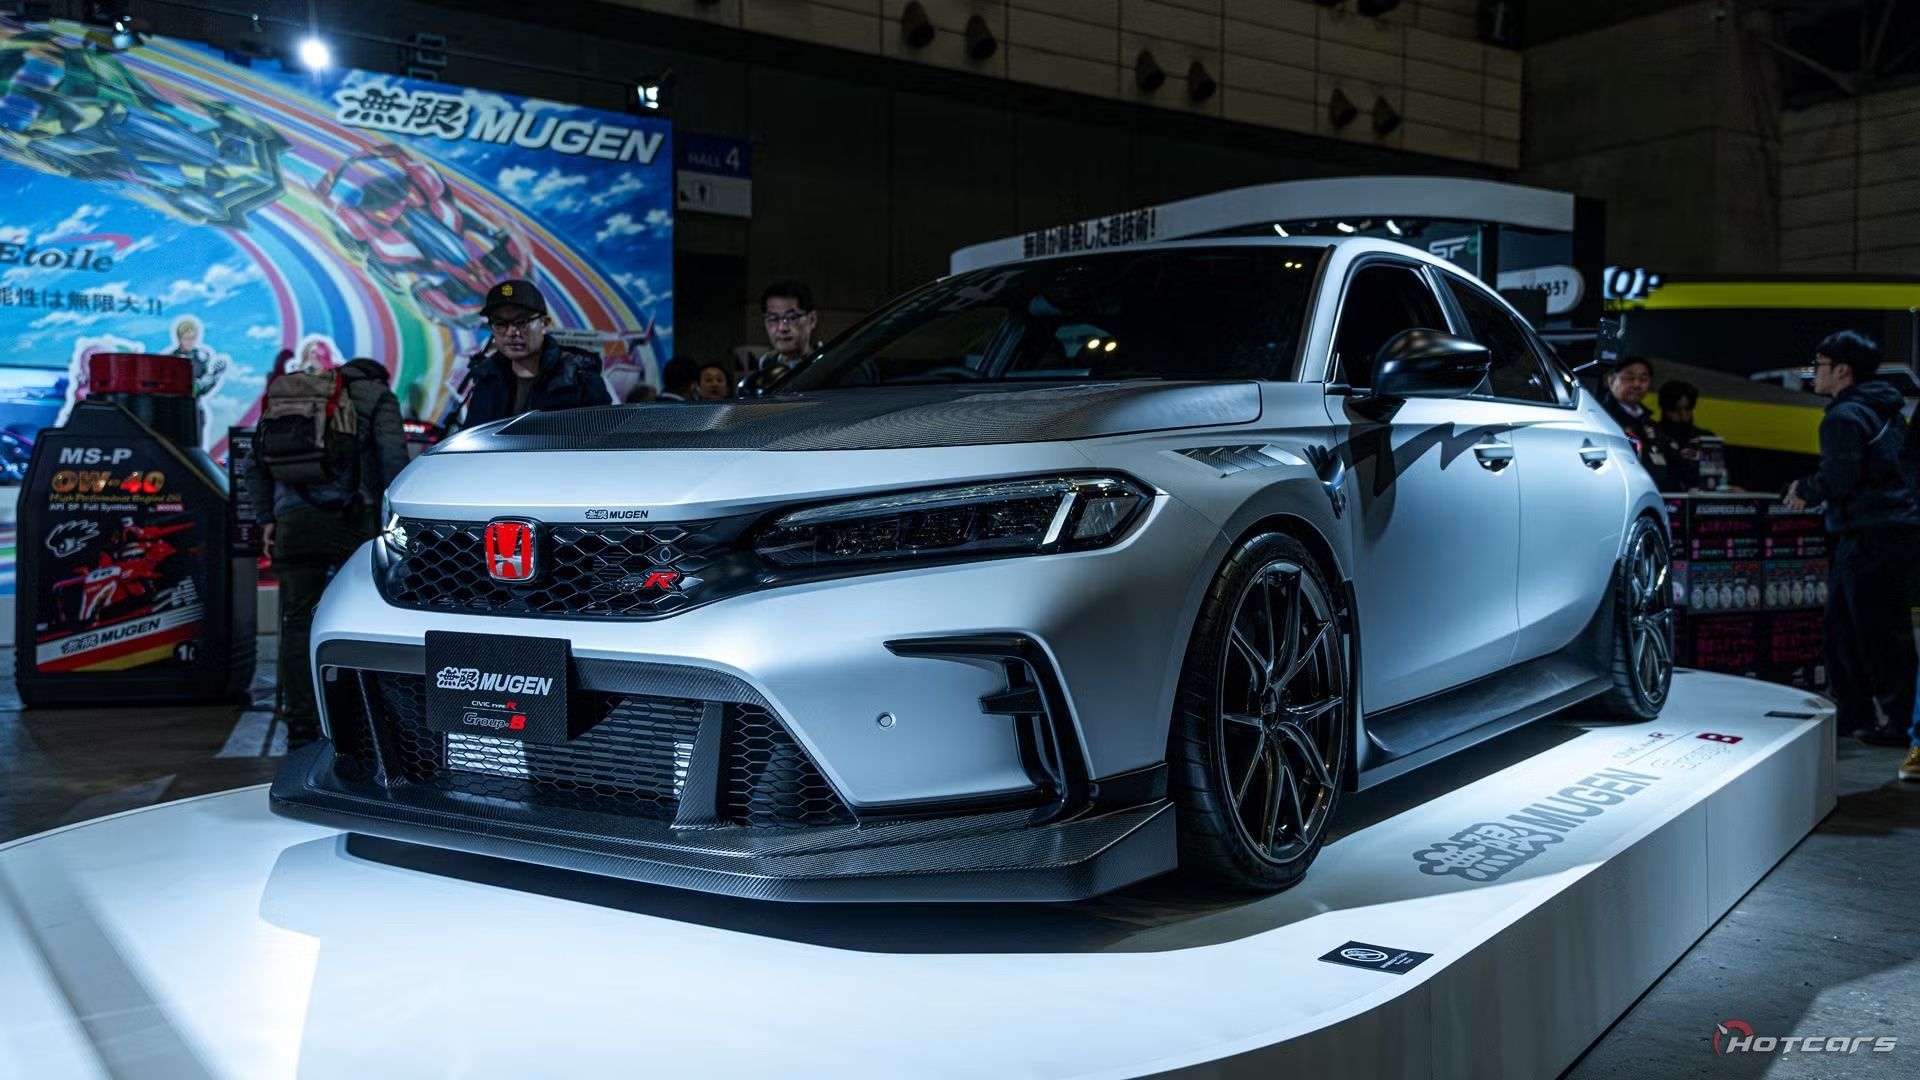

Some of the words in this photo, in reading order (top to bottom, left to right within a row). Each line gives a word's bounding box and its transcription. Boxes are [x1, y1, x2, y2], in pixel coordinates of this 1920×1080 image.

[337, 84, 467, 138] 無限
[467, 109, 664, 164] MUGEN
[725, 146, 741, 172] 4
[59, 447, 133, 465] MS-P
[609, 510, 649, 519] MUGEN
[100, 618, 161, 644] MUGEN
[437, 667, 479, 690] 無限
[479, 673, 553, 695] MUGEN
[471, 700, 491, 708] CIVIC
[1507, 768, 1663, 833] MUGEN
